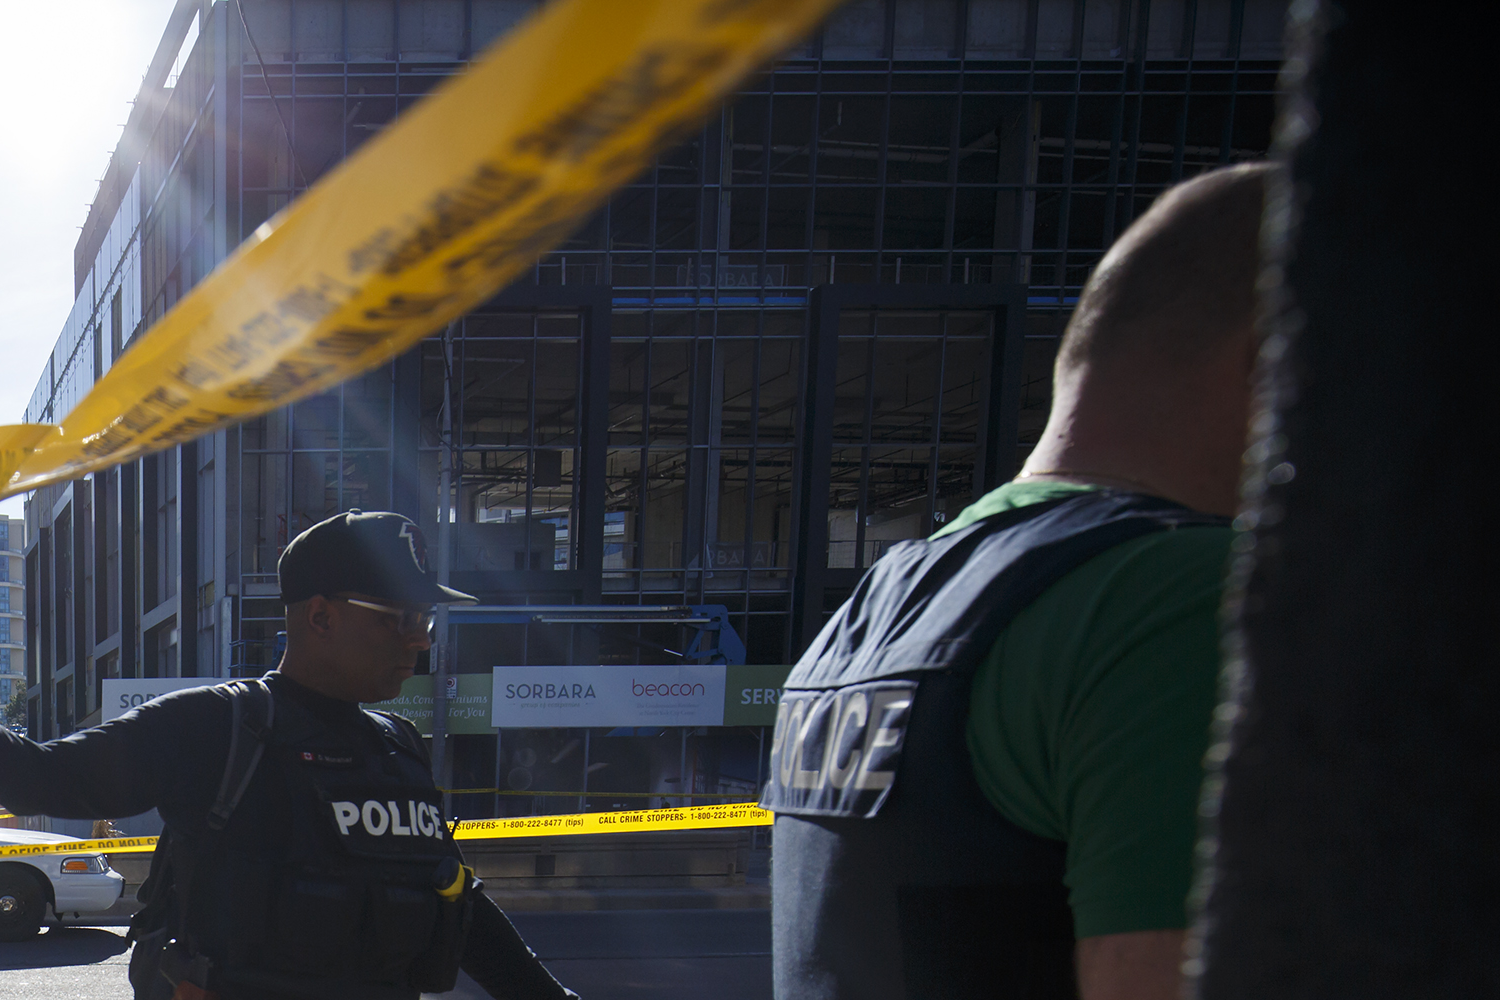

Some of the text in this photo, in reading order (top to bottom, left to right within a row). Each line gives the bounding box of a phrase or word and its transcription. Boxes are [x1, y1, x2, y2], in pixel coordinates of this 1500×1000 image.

[505, 683, 596, 699] SORBARA
[632, 678, 705, 697] beacon
[448, 708, 465, 717] For
[465, 708, 485, 719] You
[772, 689, 912, 790] POLICE
[331, 799, 443, 840] POLICE
[503, 819, 562, 829] 1-800-222-8477
[565, 818, 584, 828] (tips)
[598, 816, 617, 825] CALL
[619, 814, 644, 823] CRIME
[690, 810, 747, 821] 1-800-222-8477
[749, 809, 768, 820] (tips)
